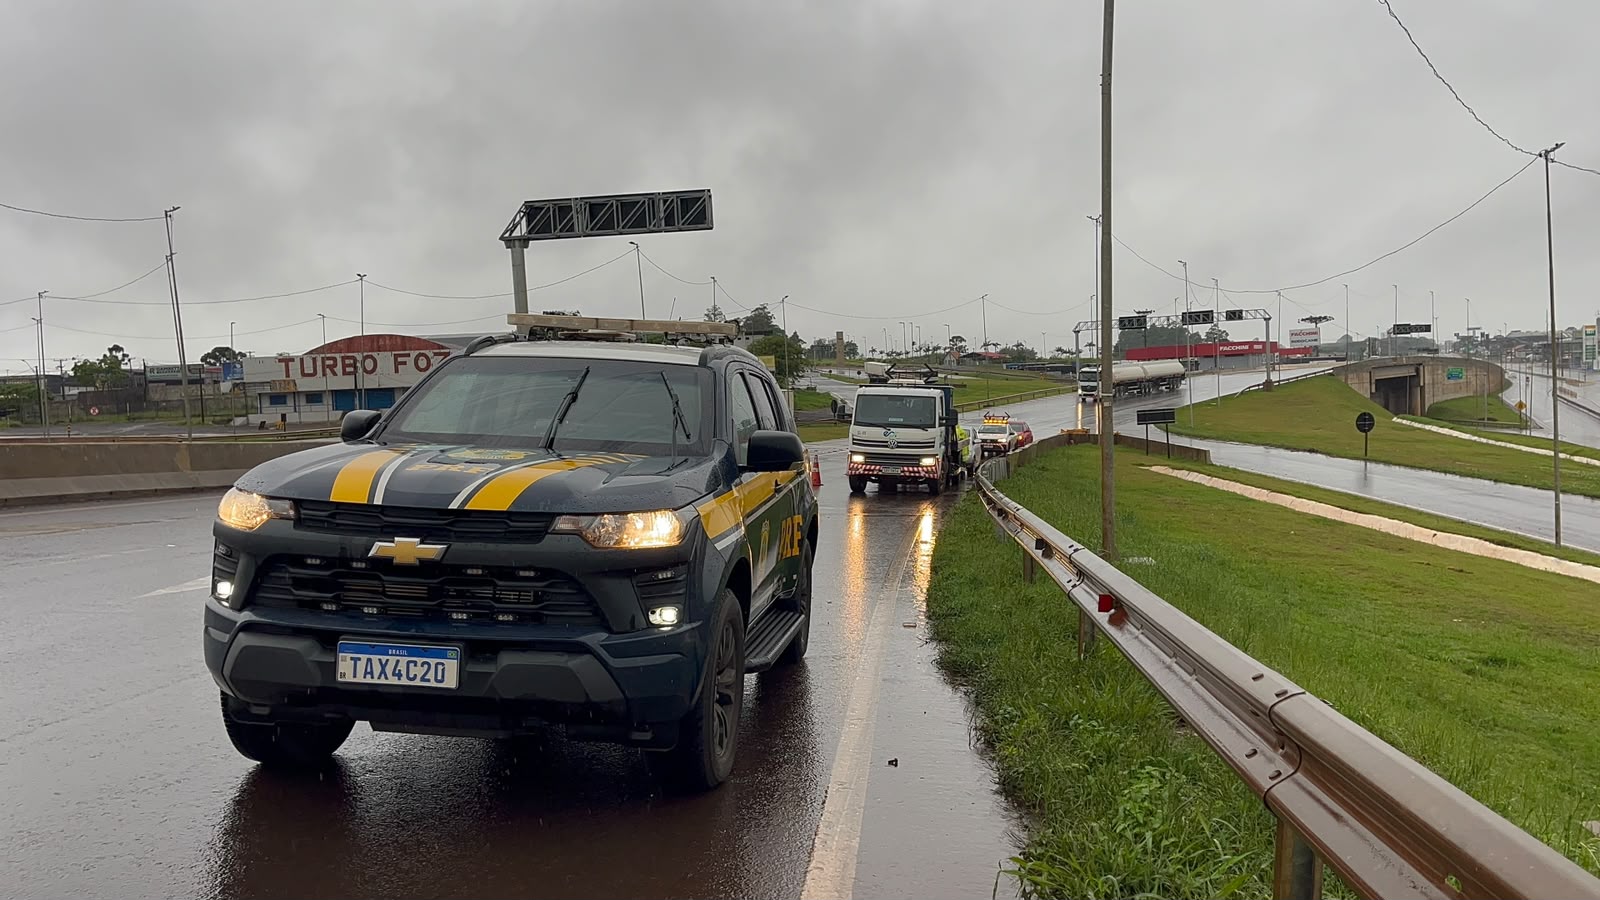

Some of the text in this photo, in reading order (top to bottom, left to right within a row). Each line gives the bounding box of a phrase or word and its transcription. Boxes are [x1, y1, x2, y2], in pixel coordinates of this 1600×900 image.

[278, 354, 378, 378] TURBO
[405, 463, 494, 474] PRF
[778, 514, 803, 561] PRF
[388, 648, 408, 656] BRASIL
[339, 671, 347, 679] BR
[350, 656, 446, 684] TAX4C20
